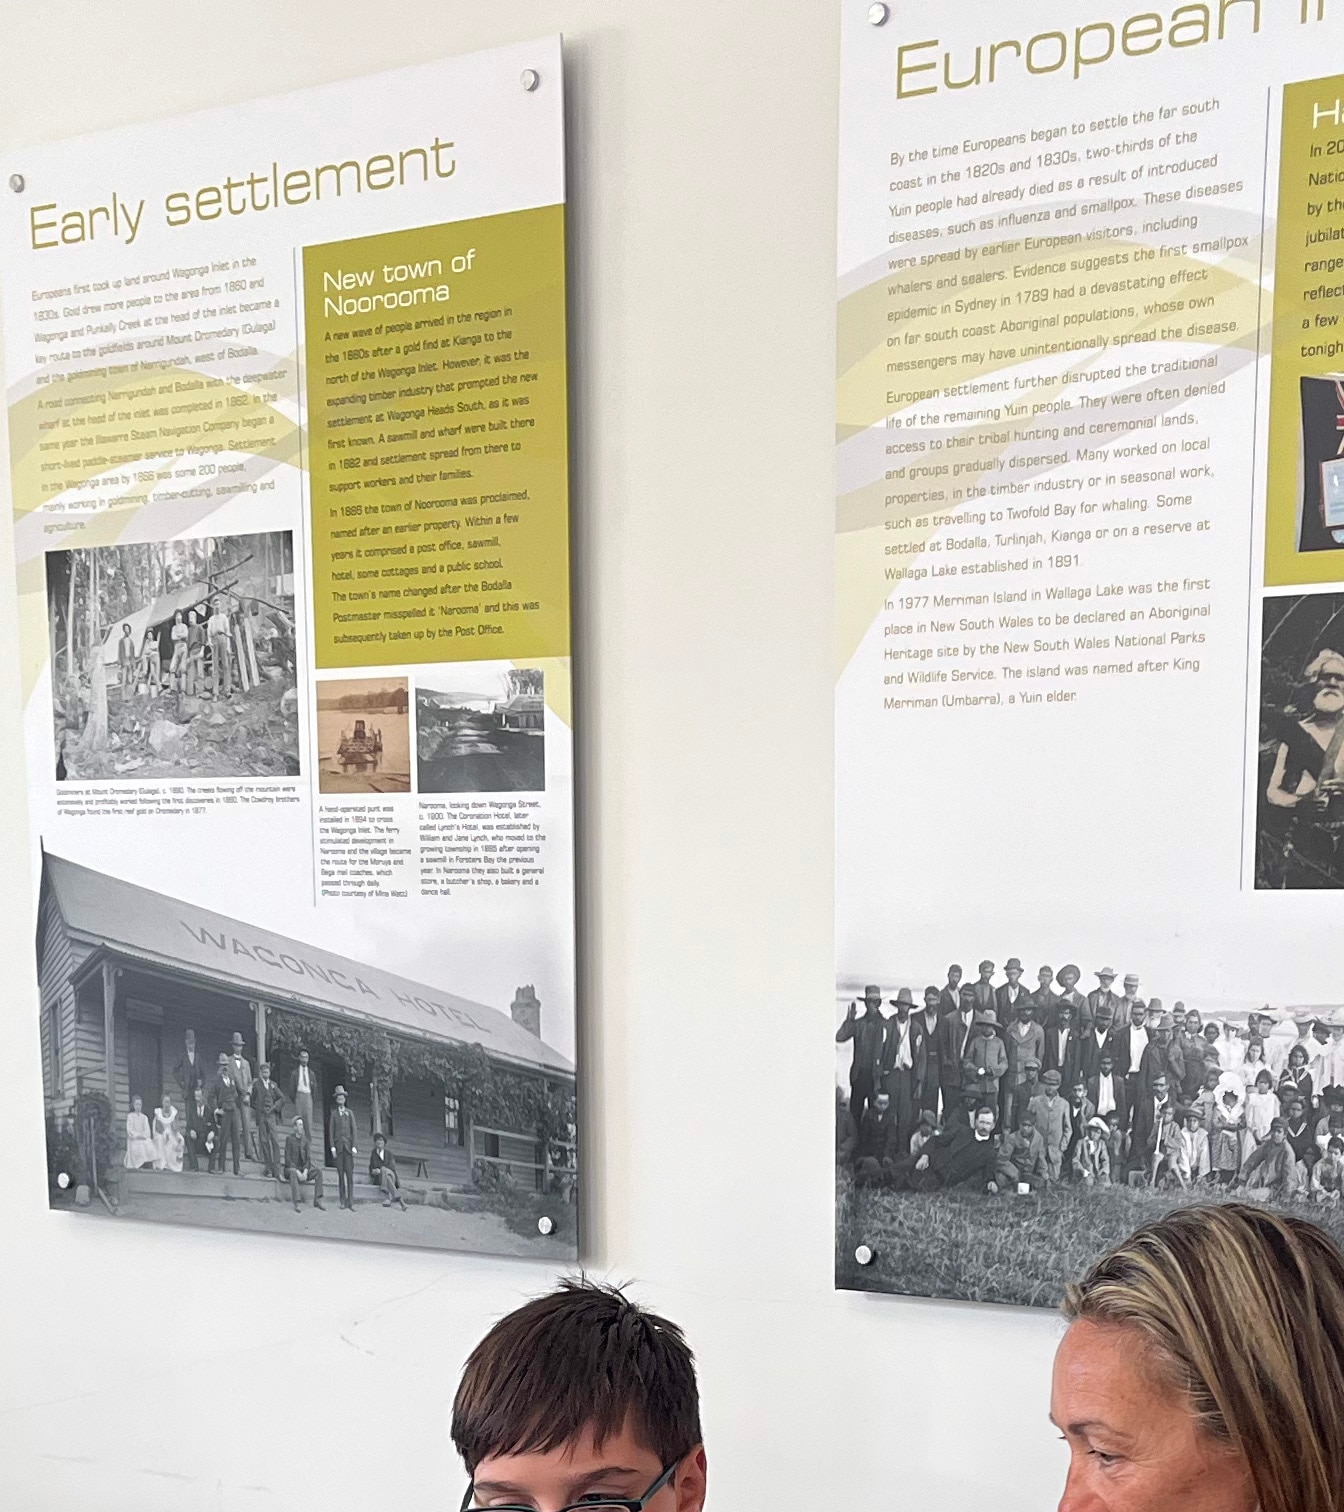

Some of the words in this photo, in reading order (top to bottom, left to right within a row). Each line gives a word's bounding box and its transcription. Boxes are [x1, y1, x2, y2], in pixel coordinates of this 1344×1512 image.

[895, 0, 1262, 99] European
[1310, 144, 1322, 158] In
[30, 193, 145, 249] Early
[165, 137, 456, 226] settlement
[324, 268, 375, 292] New
[383, 258, 441, 284] town
[451, 249, 475, 274] of
[324, 285, 450, 317] Noorooma
[332, 612, 382, 623] Postmaster
[383, 607, 426, 620] misspelled
[428, 607, 436, 617] it
[438, 602, 481, 616] 'Narooma'
[484, 601, 500, 613] and
[502, 601, 520, 612] this
[522, 601, 540, 610] was
[884, 697, 938, 709] Merriman
[942, 692, 1004, 707] (Umbarra),
[1008, 694, 1015, 704] a
[1019, 691, 1042, 703] Yuin
[389, 987, 492, 1034] HOTEL
